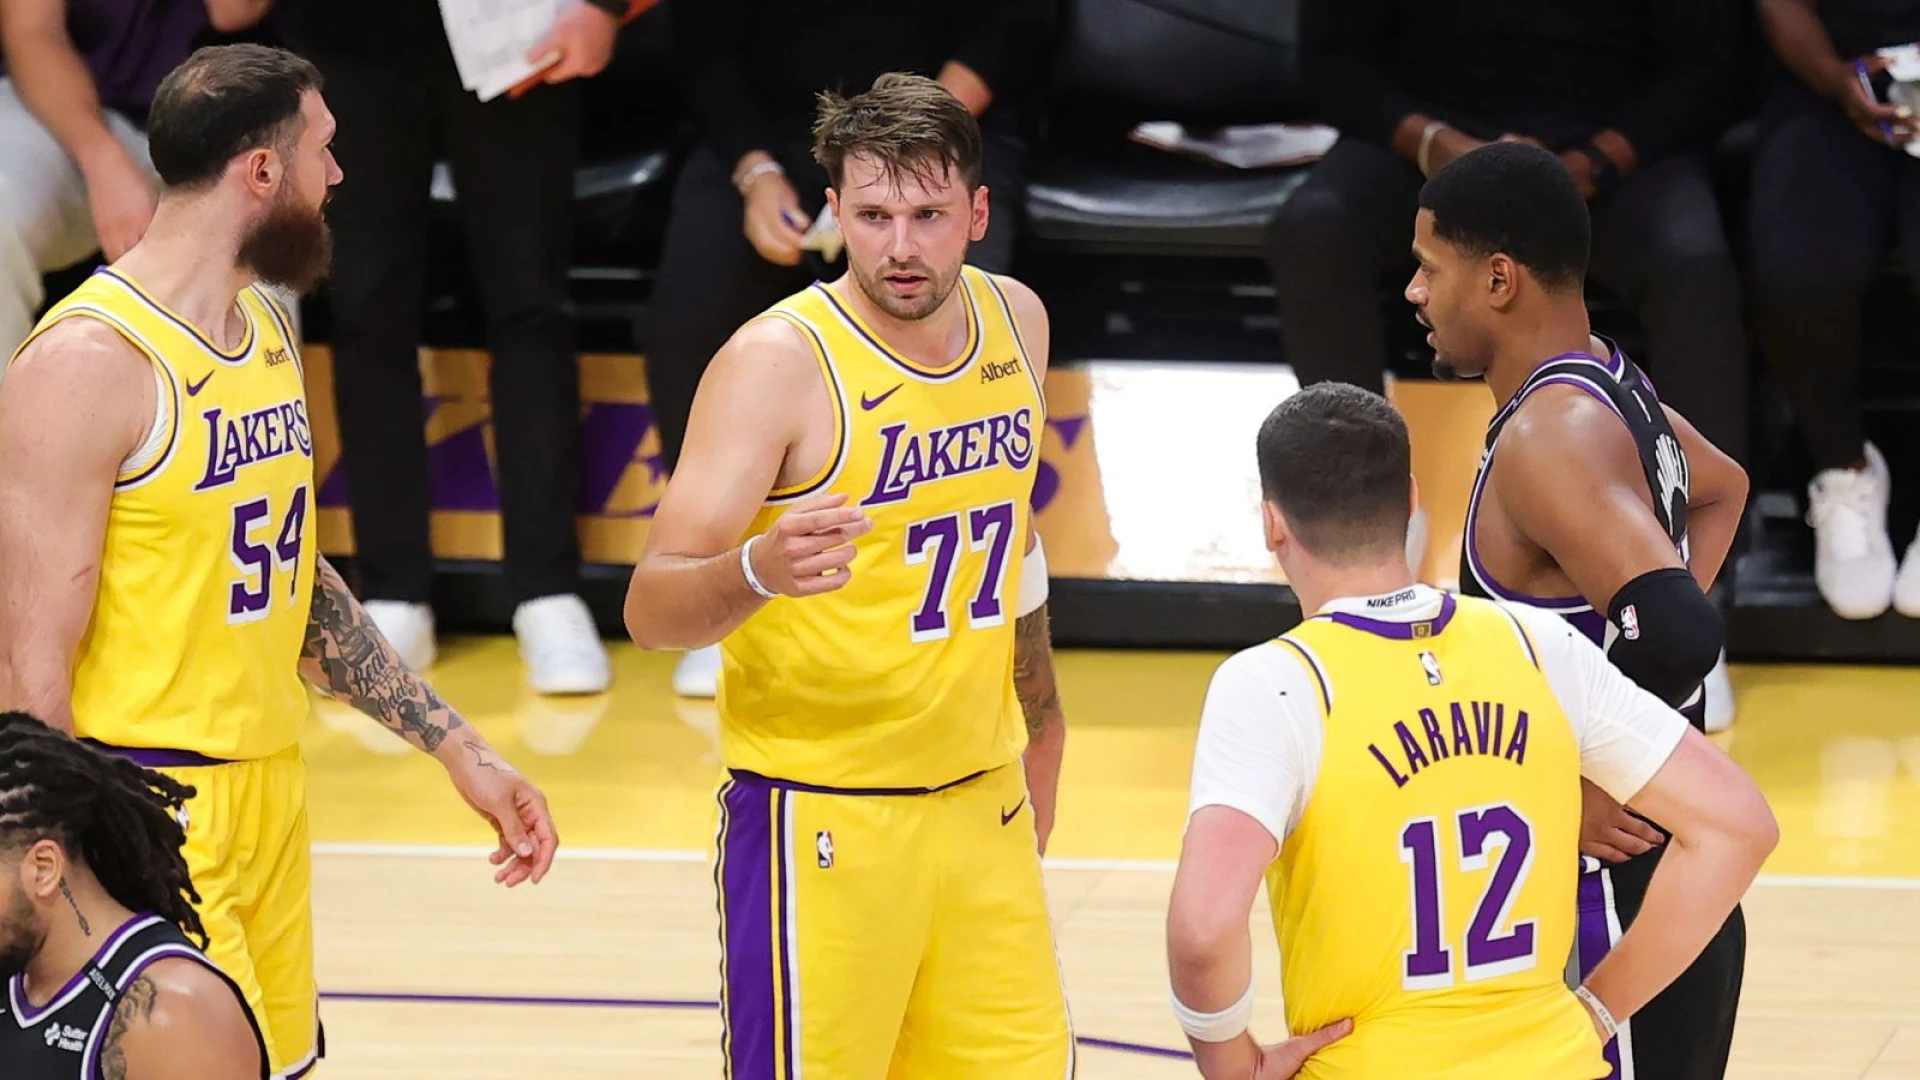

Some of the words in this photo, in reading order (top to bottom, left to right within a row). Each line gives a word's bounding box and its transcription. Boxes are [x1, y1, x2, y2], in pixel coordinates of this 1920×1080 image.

[980, 357, 1022, 385] Albert
[194, 398, 313, 491] LAKERS
[859, 408, 1034, 507] LAKERS
[229, 484, 308, 621] 54
[905, 500, 1016, 642] 77
[1366, 596, 1394, 608] NIKE
[1394, 589, 1417, 604] PRO
[1367, 700, 1529, 789] LARAVIA
[1399, 802, 1538, 990] 12
